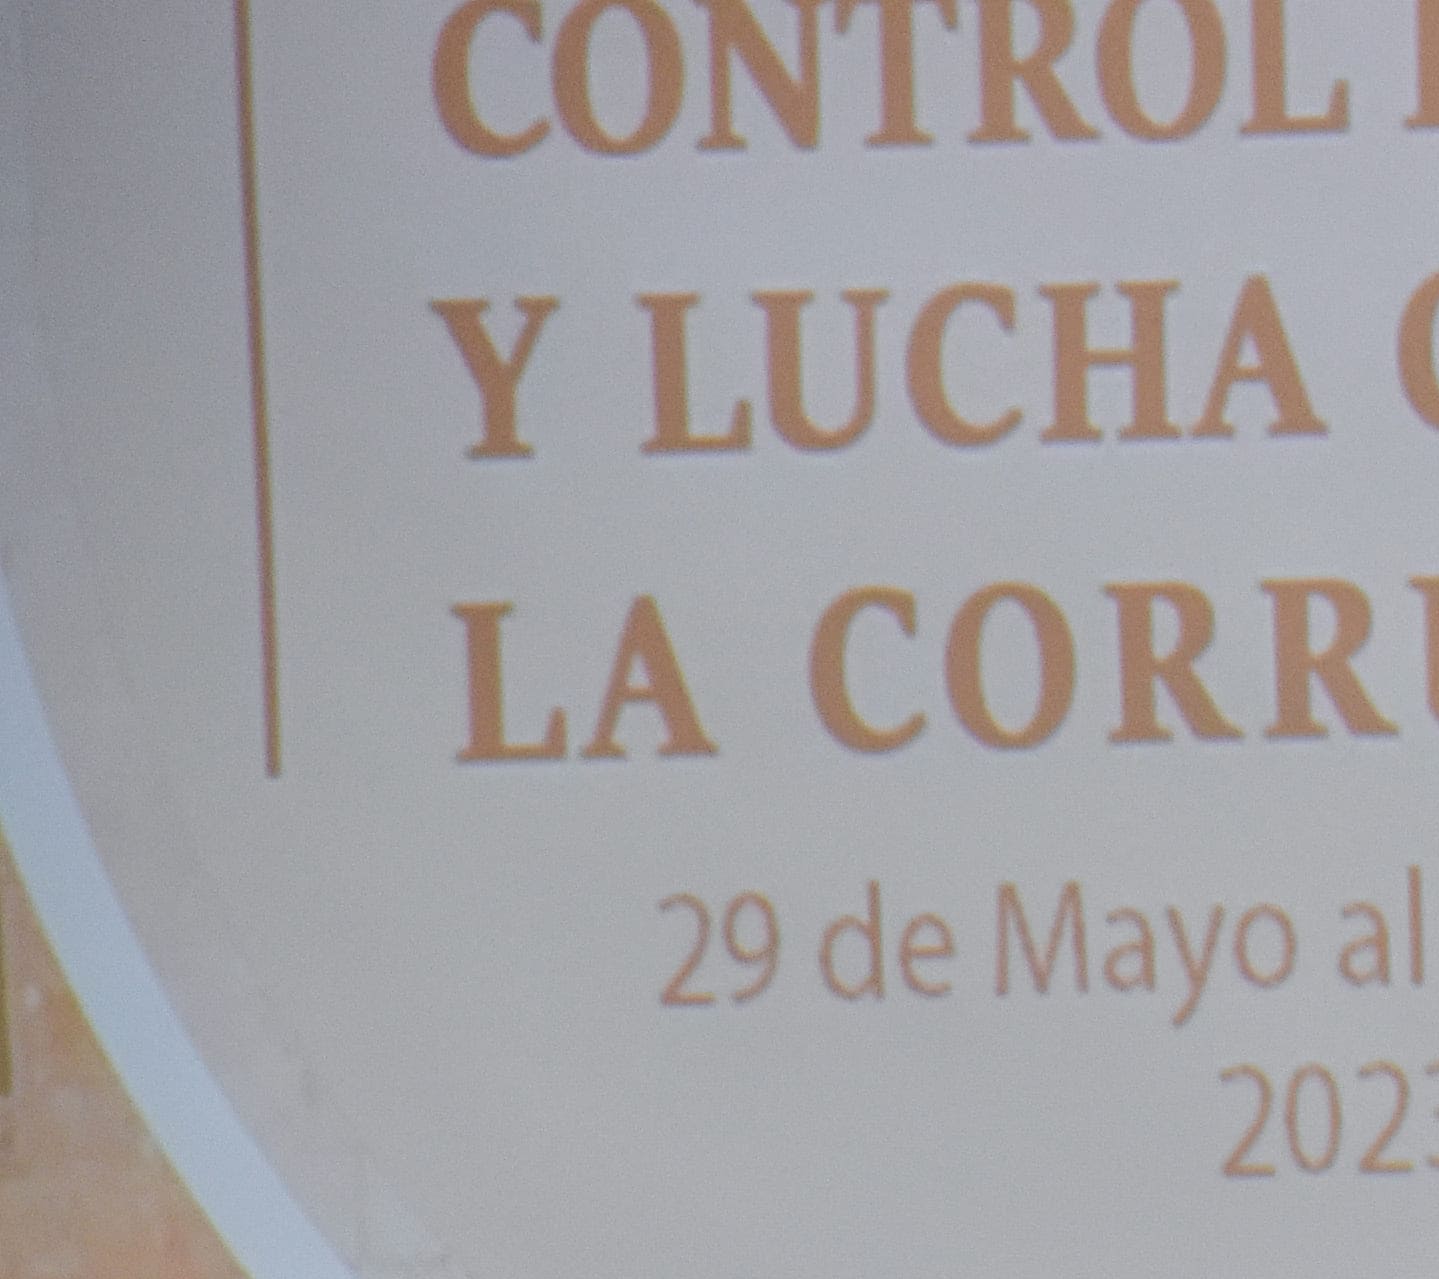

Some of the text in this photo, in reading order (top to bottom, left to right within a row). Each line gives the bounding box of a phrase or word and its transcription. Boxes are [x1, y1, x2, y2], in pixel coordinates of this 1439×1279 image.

[434, 0, 1350, 157] CONTROL
[433, 297, 558, 458] Y
[639, 276, 1328, 453] LUCHA
[454, 596, 720, 761] LA
[661, 891, 780, 1005] 29
[818, 880, 955, 1000] de
[997, 880, 1298, 1027] Mayo
[1340, 866, 1423, 984] al
